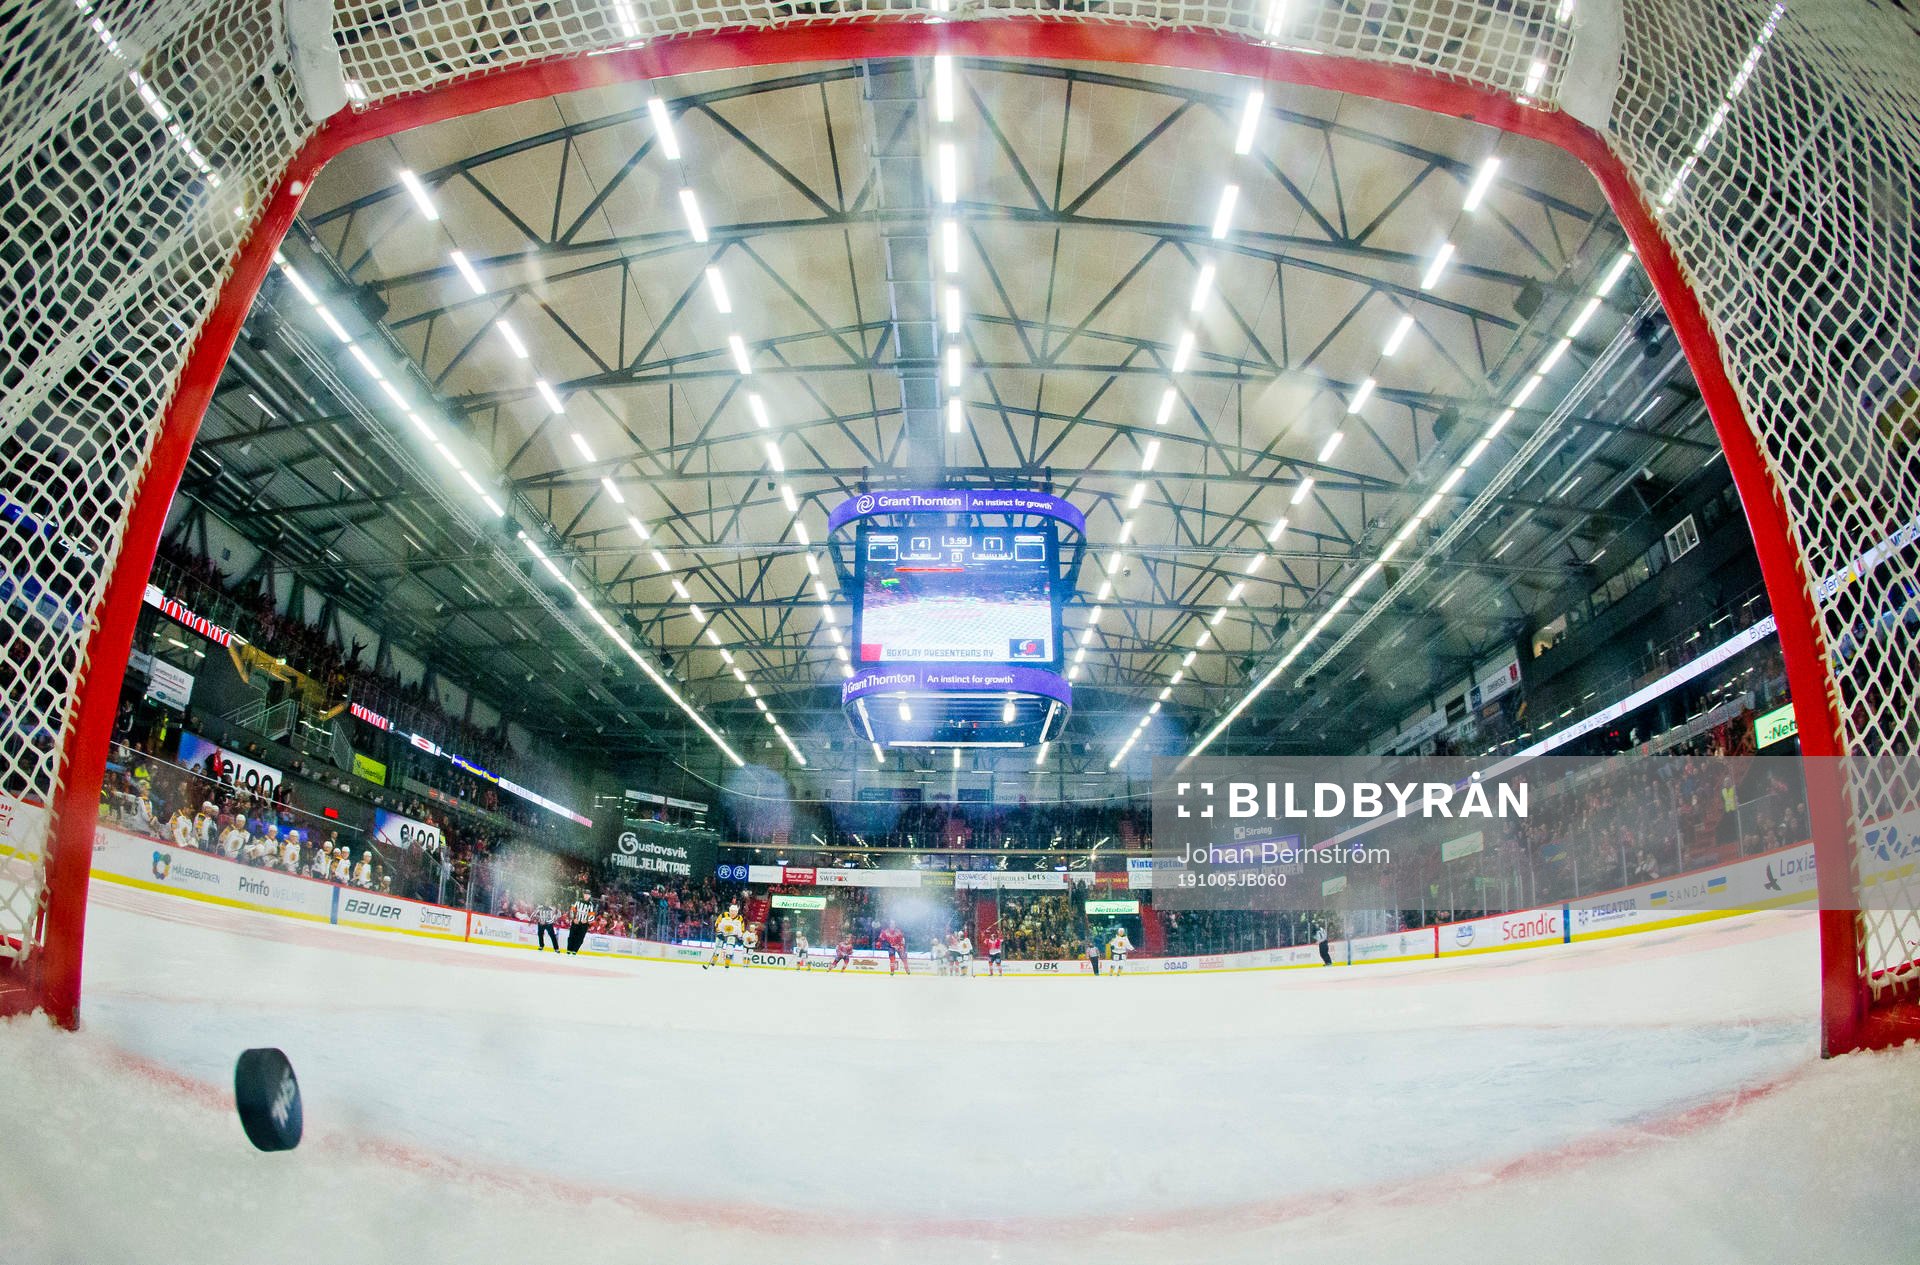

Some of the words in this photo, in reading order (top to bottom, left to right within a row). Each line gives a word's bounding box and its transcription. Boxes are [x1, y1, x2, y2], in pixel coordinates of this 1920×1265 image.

[985, 498, 1013, 506] instinct
[1014, 498, 1026, 507] for
[927, 674, 939, 683] An
[940, 674, 970, 684] instinct
[972, 674, 983, 684] for
[617, 831, 688, 859] Gustavsvik
[239, 876, 270, 897] Prinfo
[1668, 884, 1707, 903] SANDA
[1502, 912, 1557, 941] Scandic
[1034, 962, 1059, 970] OBK
